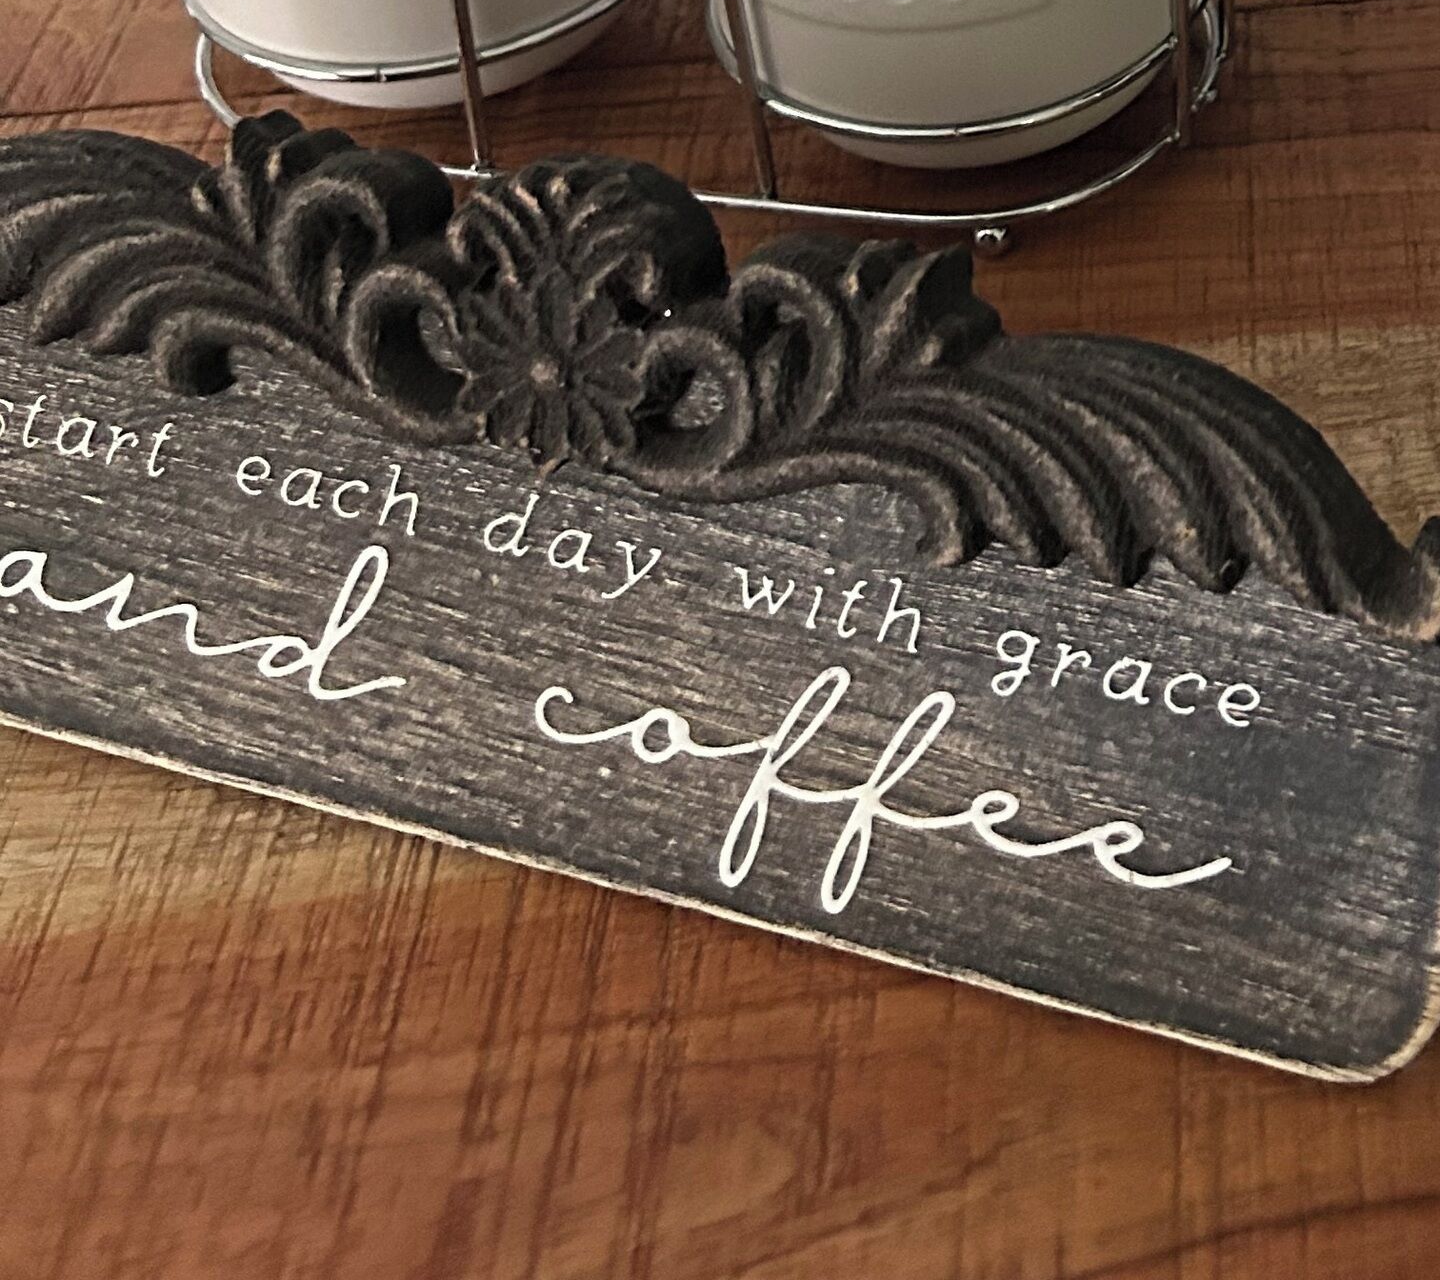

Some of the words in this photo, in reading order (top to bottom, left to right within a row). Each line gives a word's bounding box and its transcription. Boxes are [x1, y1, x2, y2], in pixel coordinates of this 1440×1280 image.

[0, 545, 406, 699] and
[535, 666, 1232, 914] coffee
[236, 455, 420, 535] each
[484, 494, 662, 599] day
[734, 566, 921, 652] with
[996, 628, 1261, 727] grace
